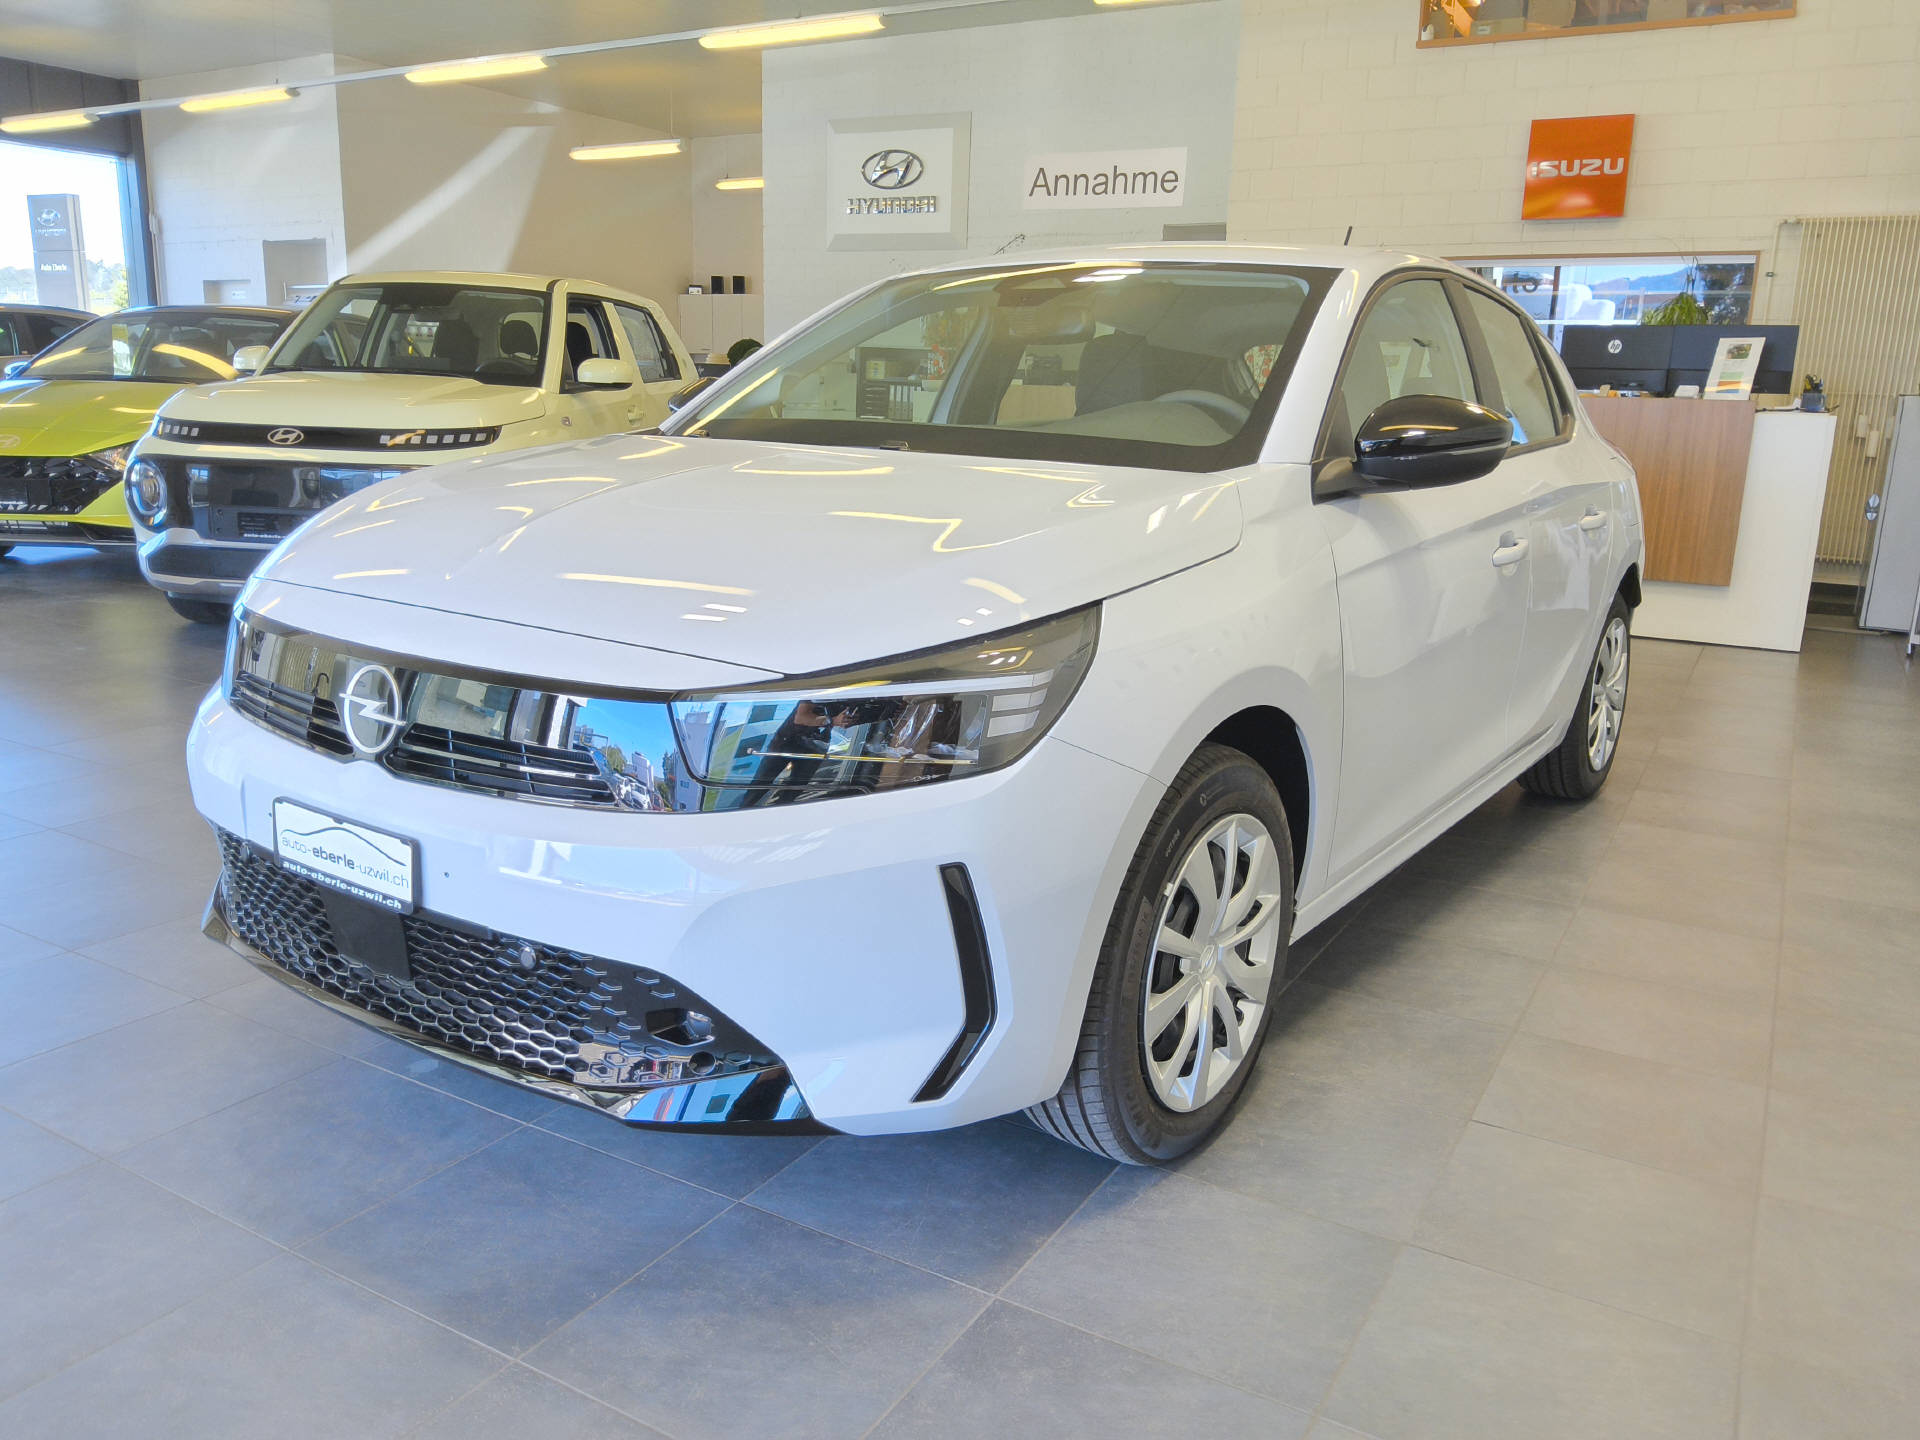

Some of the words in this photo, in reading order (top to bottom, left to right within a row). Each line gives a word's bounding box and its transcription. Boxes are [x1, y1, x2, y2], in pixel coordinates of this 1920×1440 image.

[1530, 157, 1625, 178] ISUZU
[1029, 165, 1179, 197] Annahme
[846, 195, 937, 215] HYUNDAI
[1608, 339, 1622, 354] hp
[281, 836, 409, 889] auto-eberle-uzwil.ch
[282, 861, 402, 910] auto-eberle-uzwil.ch
